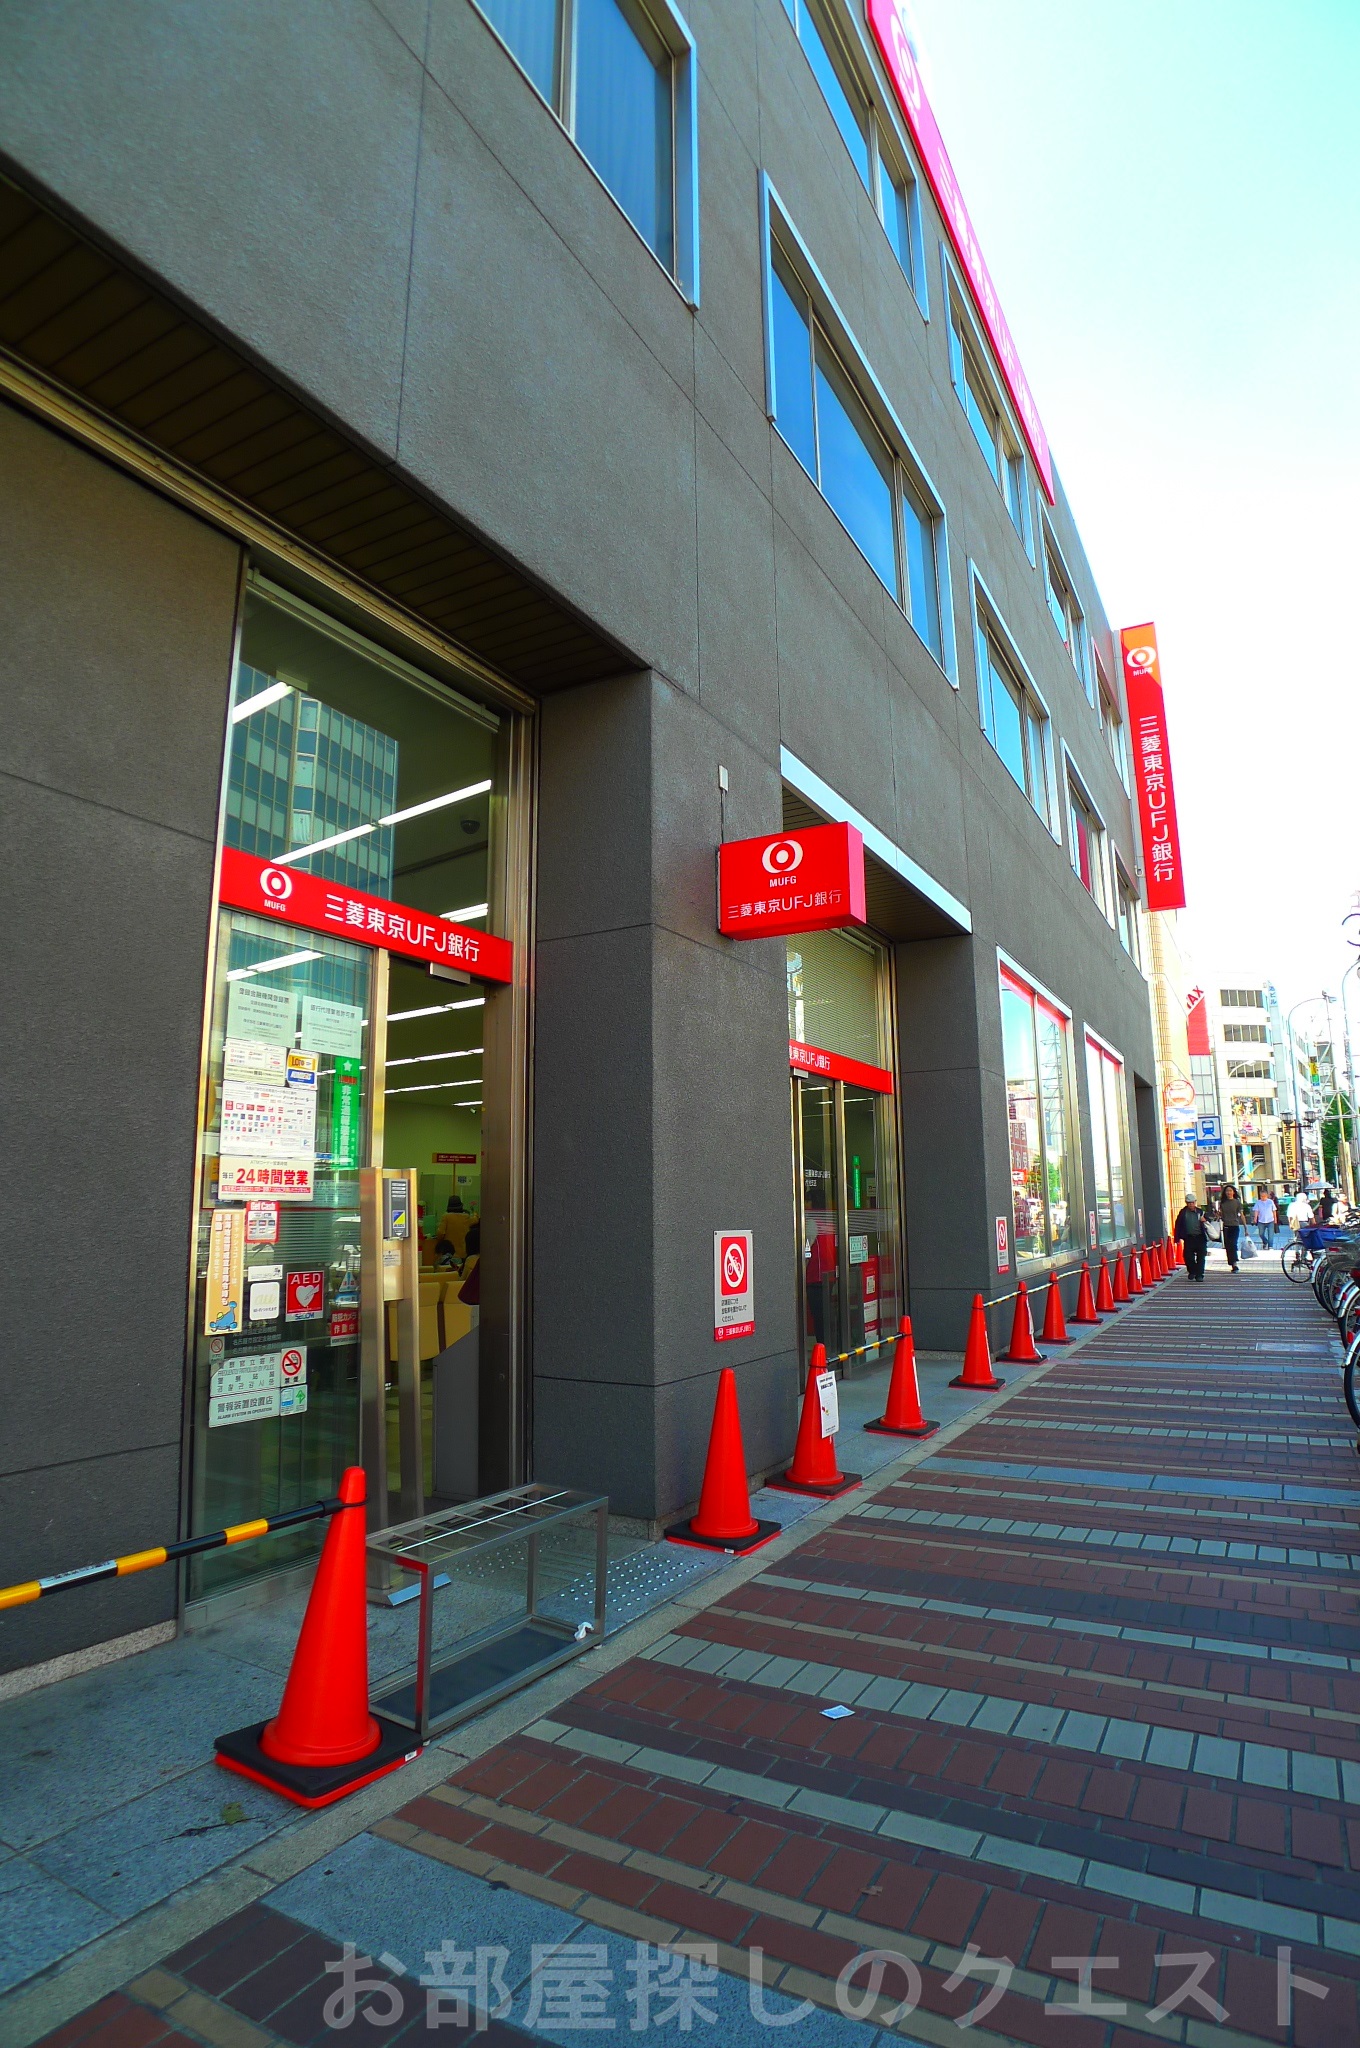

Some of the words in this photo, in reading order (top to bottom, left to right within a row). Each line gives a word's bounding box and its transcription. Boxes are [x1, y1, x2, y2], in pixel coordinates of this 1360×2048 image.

[1139, 715, 1175, 882] 三菱東京UFJ銀行
[769, 875, 797, 888] MUFG
[263, 899, 286, 912] MUFG
[727, 889, 843, 919] 三菱東京UFJ銀行
[324, 893, 480, 962] 三菱東京UFJ銀行
[222, 1171, 234, 1180] 毎日
[236, 1167, 309, 1186] 24時間営業
[290, 1273, 321, 1285] AED
